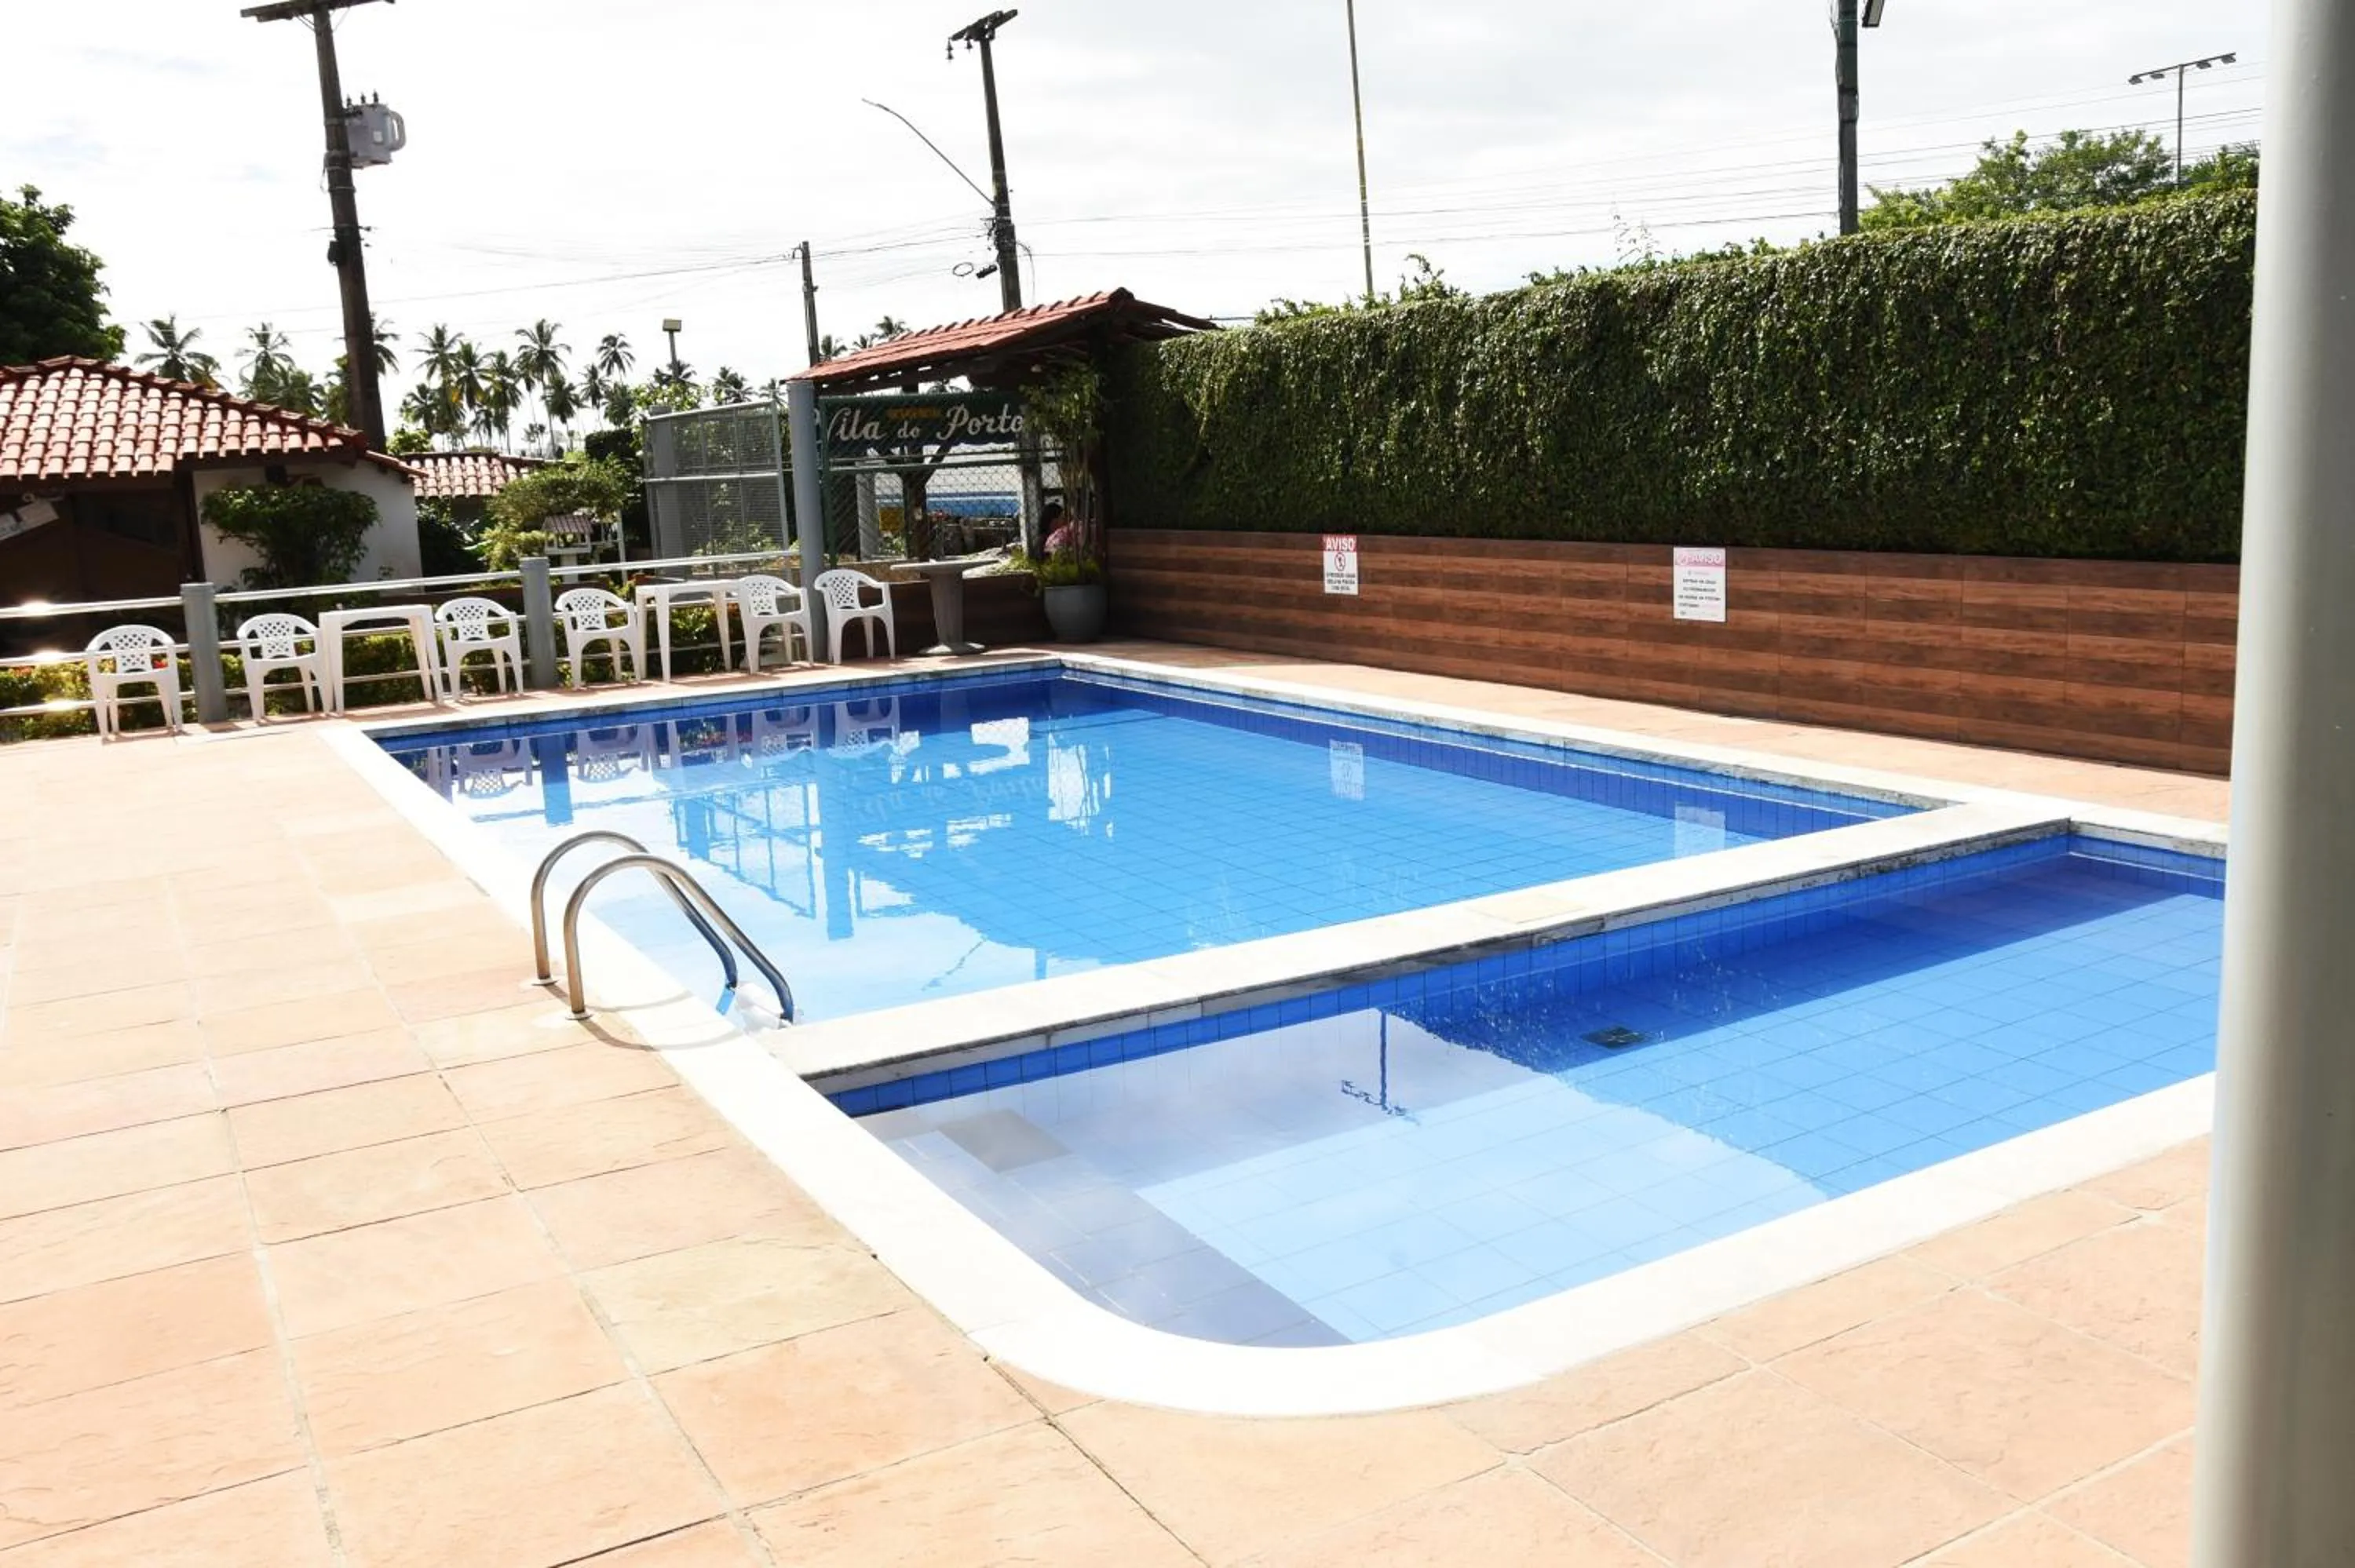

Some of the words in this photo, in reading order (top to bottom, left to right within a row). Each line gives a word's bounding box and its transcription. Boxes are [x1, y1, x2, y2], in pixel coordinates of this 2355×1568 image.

[813, 407, 888, 443] Vila
[896, 420, 922, 439] do
[935, 403, 1024, 441] Porto
[1325, 536, 1356, 551] AVISO
